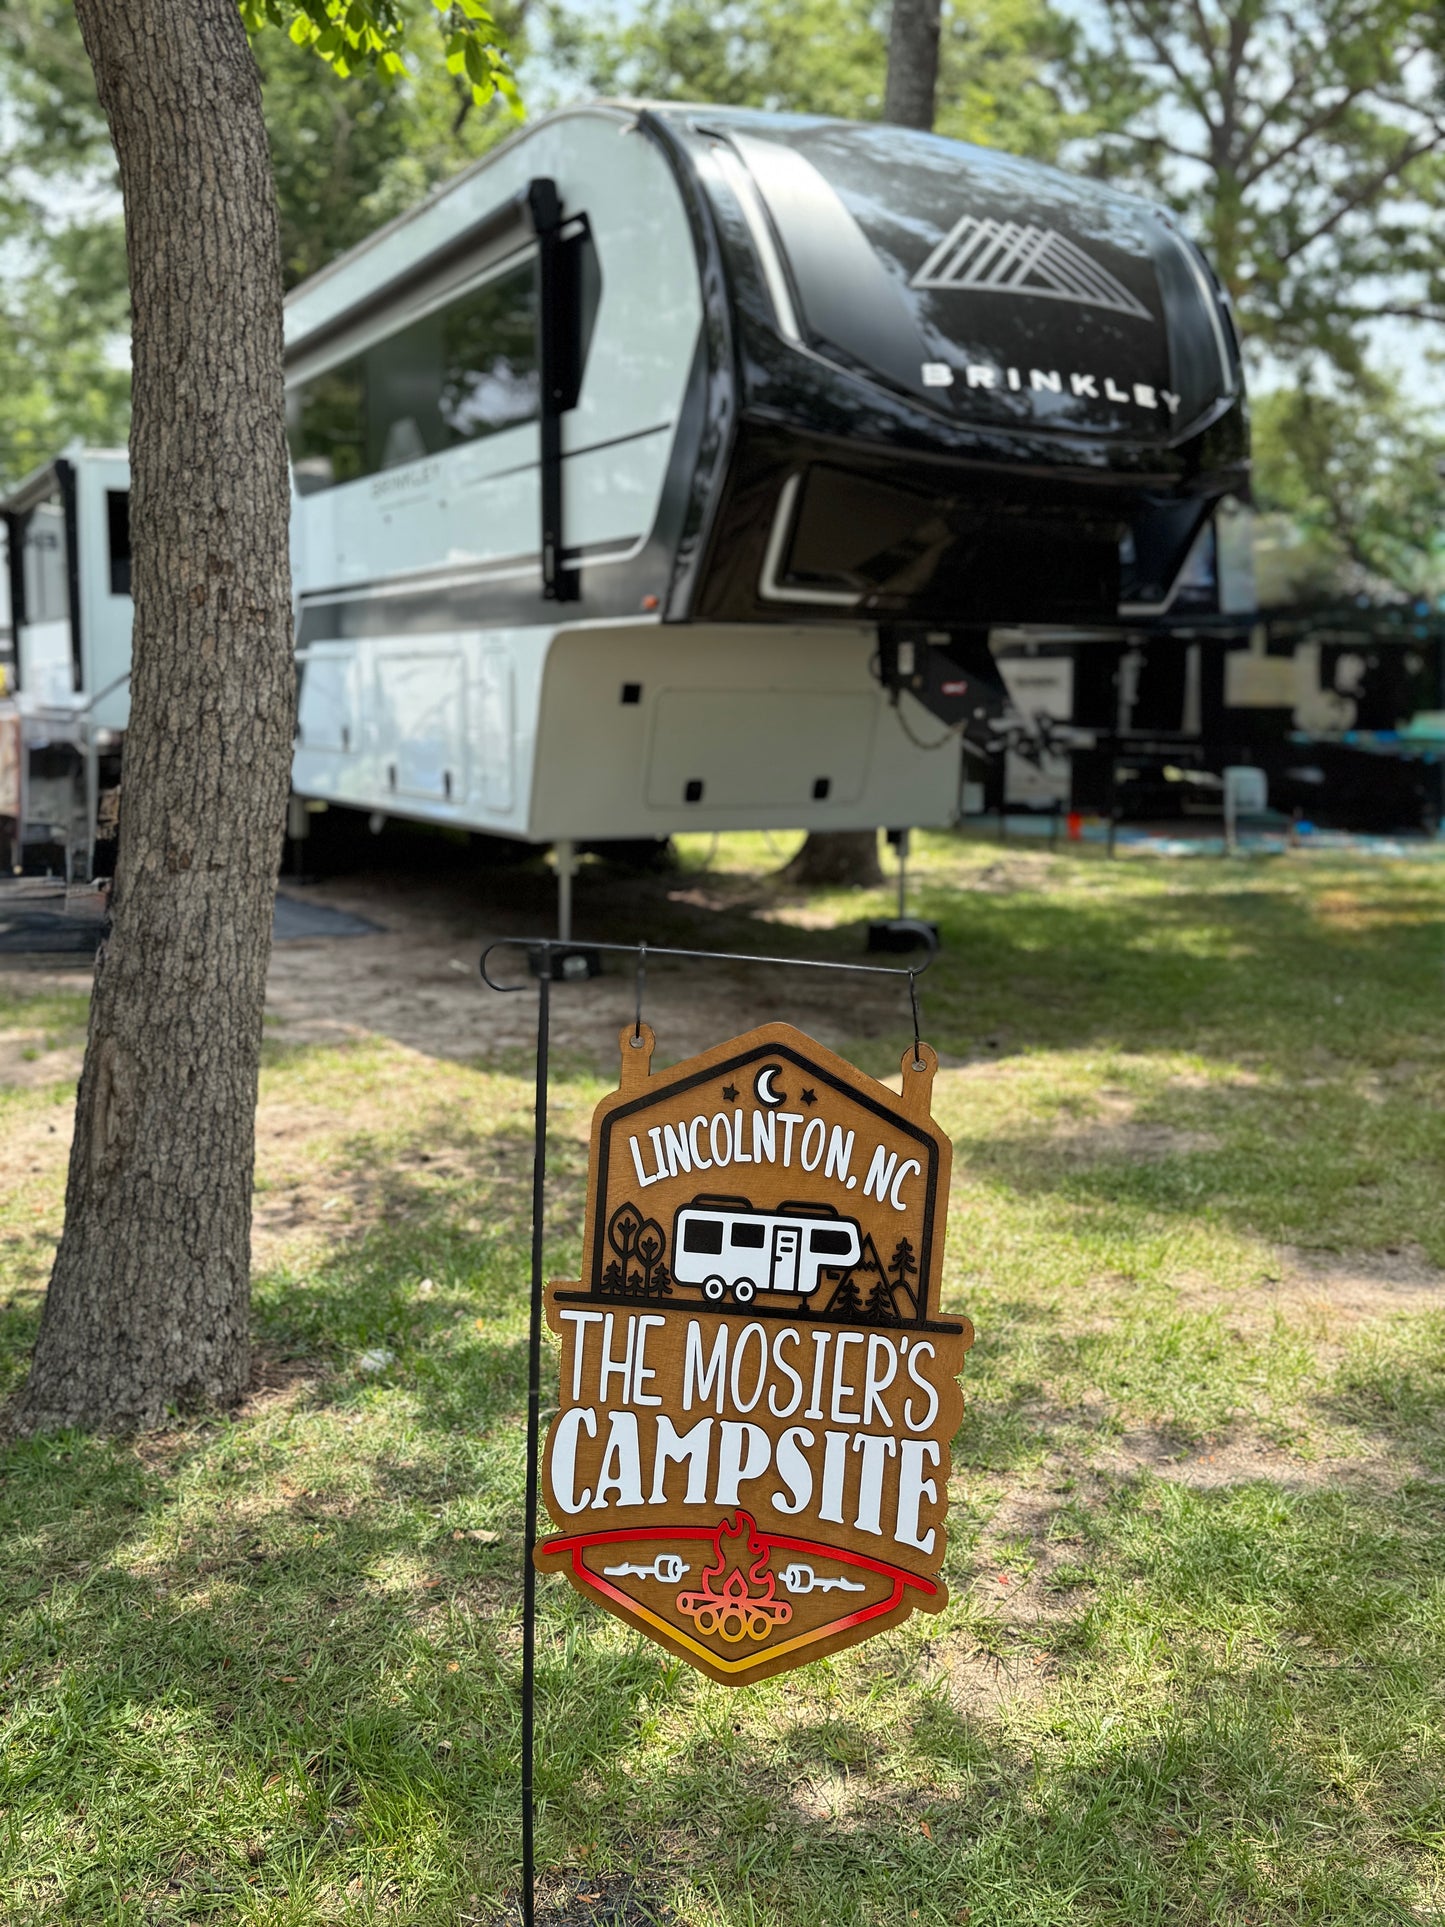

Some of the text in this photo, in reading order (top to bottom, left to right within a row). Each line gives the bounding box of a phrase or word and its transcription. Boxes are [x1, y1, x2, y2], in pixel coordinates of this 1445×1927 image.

[920, 361, 1182, 415] BRINKLEY
[629, 1108, 921, 1211] LINCOLNTON, NC
[559, 1309, 940, 1432] THE MOSIER'S
[551, 1407, 941, 1555] CAMPSITE
